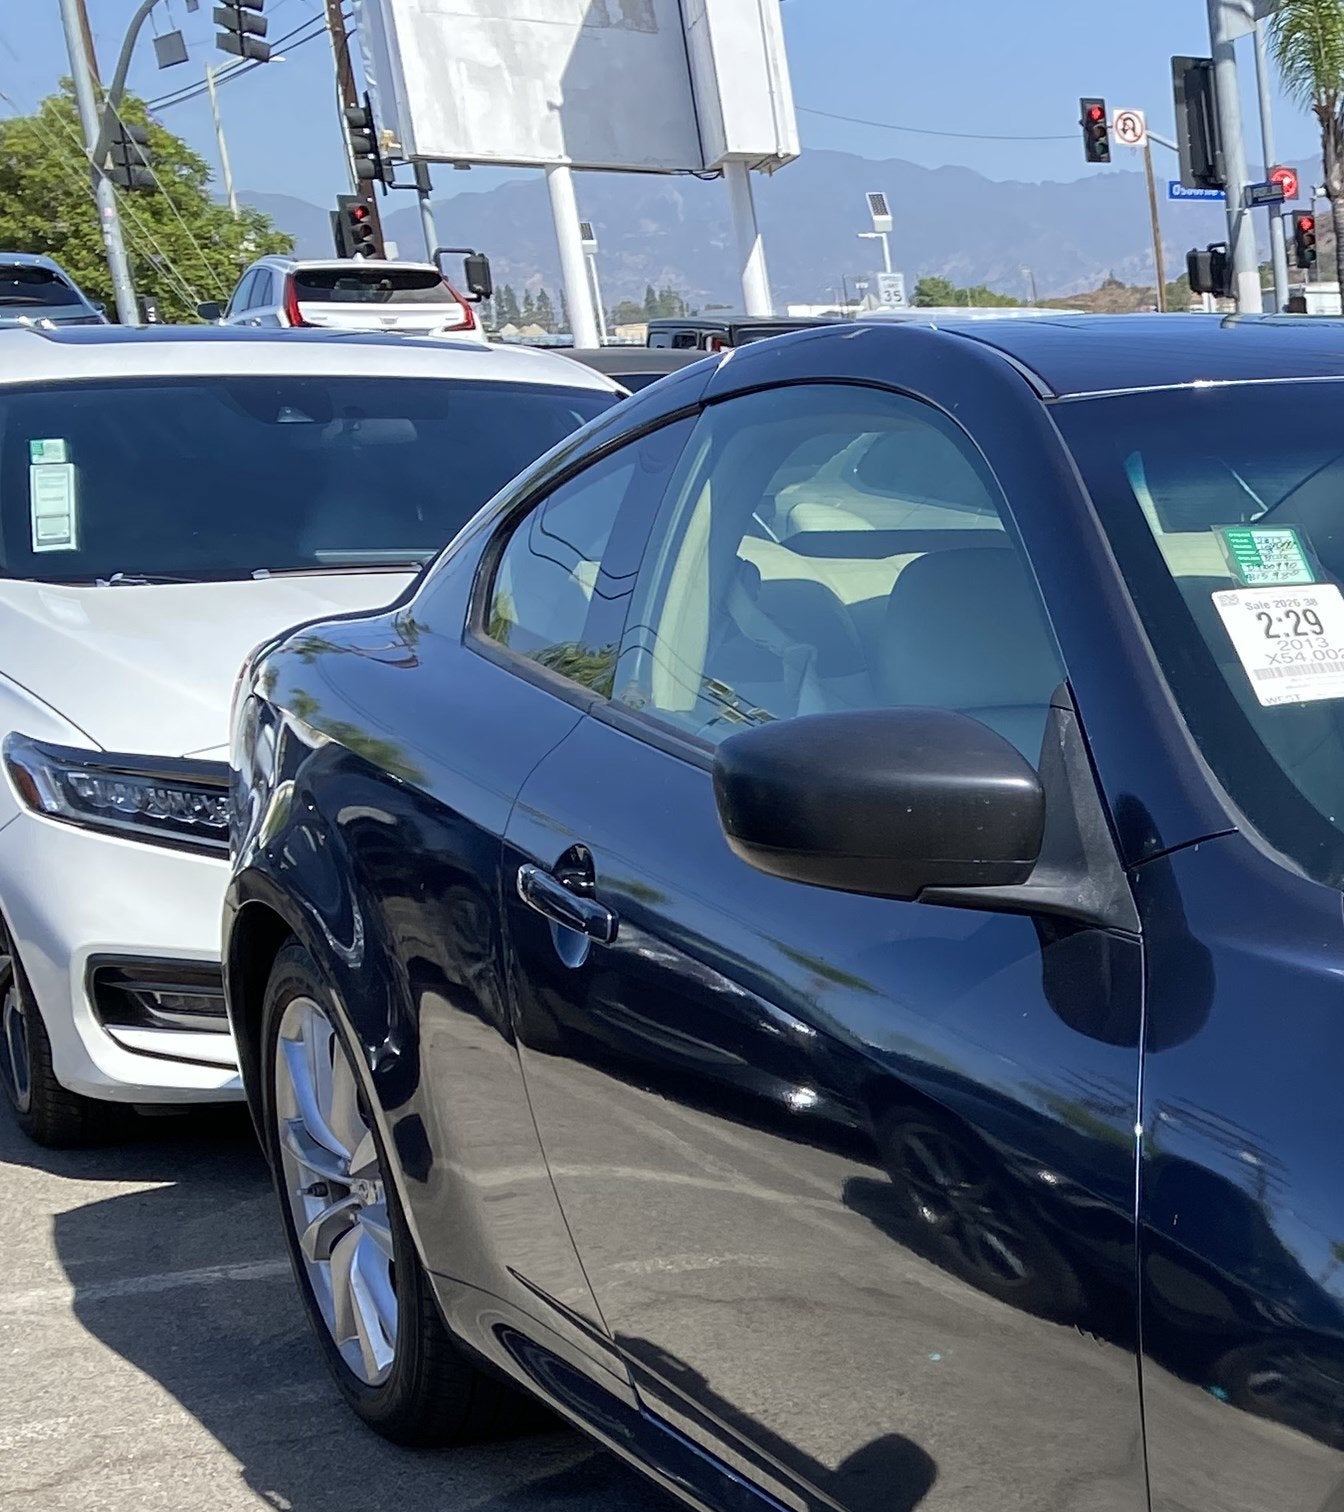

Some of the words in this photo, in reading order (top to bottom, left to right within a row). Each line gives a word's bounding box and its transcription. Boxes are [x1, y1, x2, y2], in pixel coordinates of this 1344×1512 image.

[883, 290, 902, 302] 35
[1244, 601, 1271, 611] Sale
[1255, 608, 1325, 639] 2:29
[1276, 637, 1330, 652] 2013
